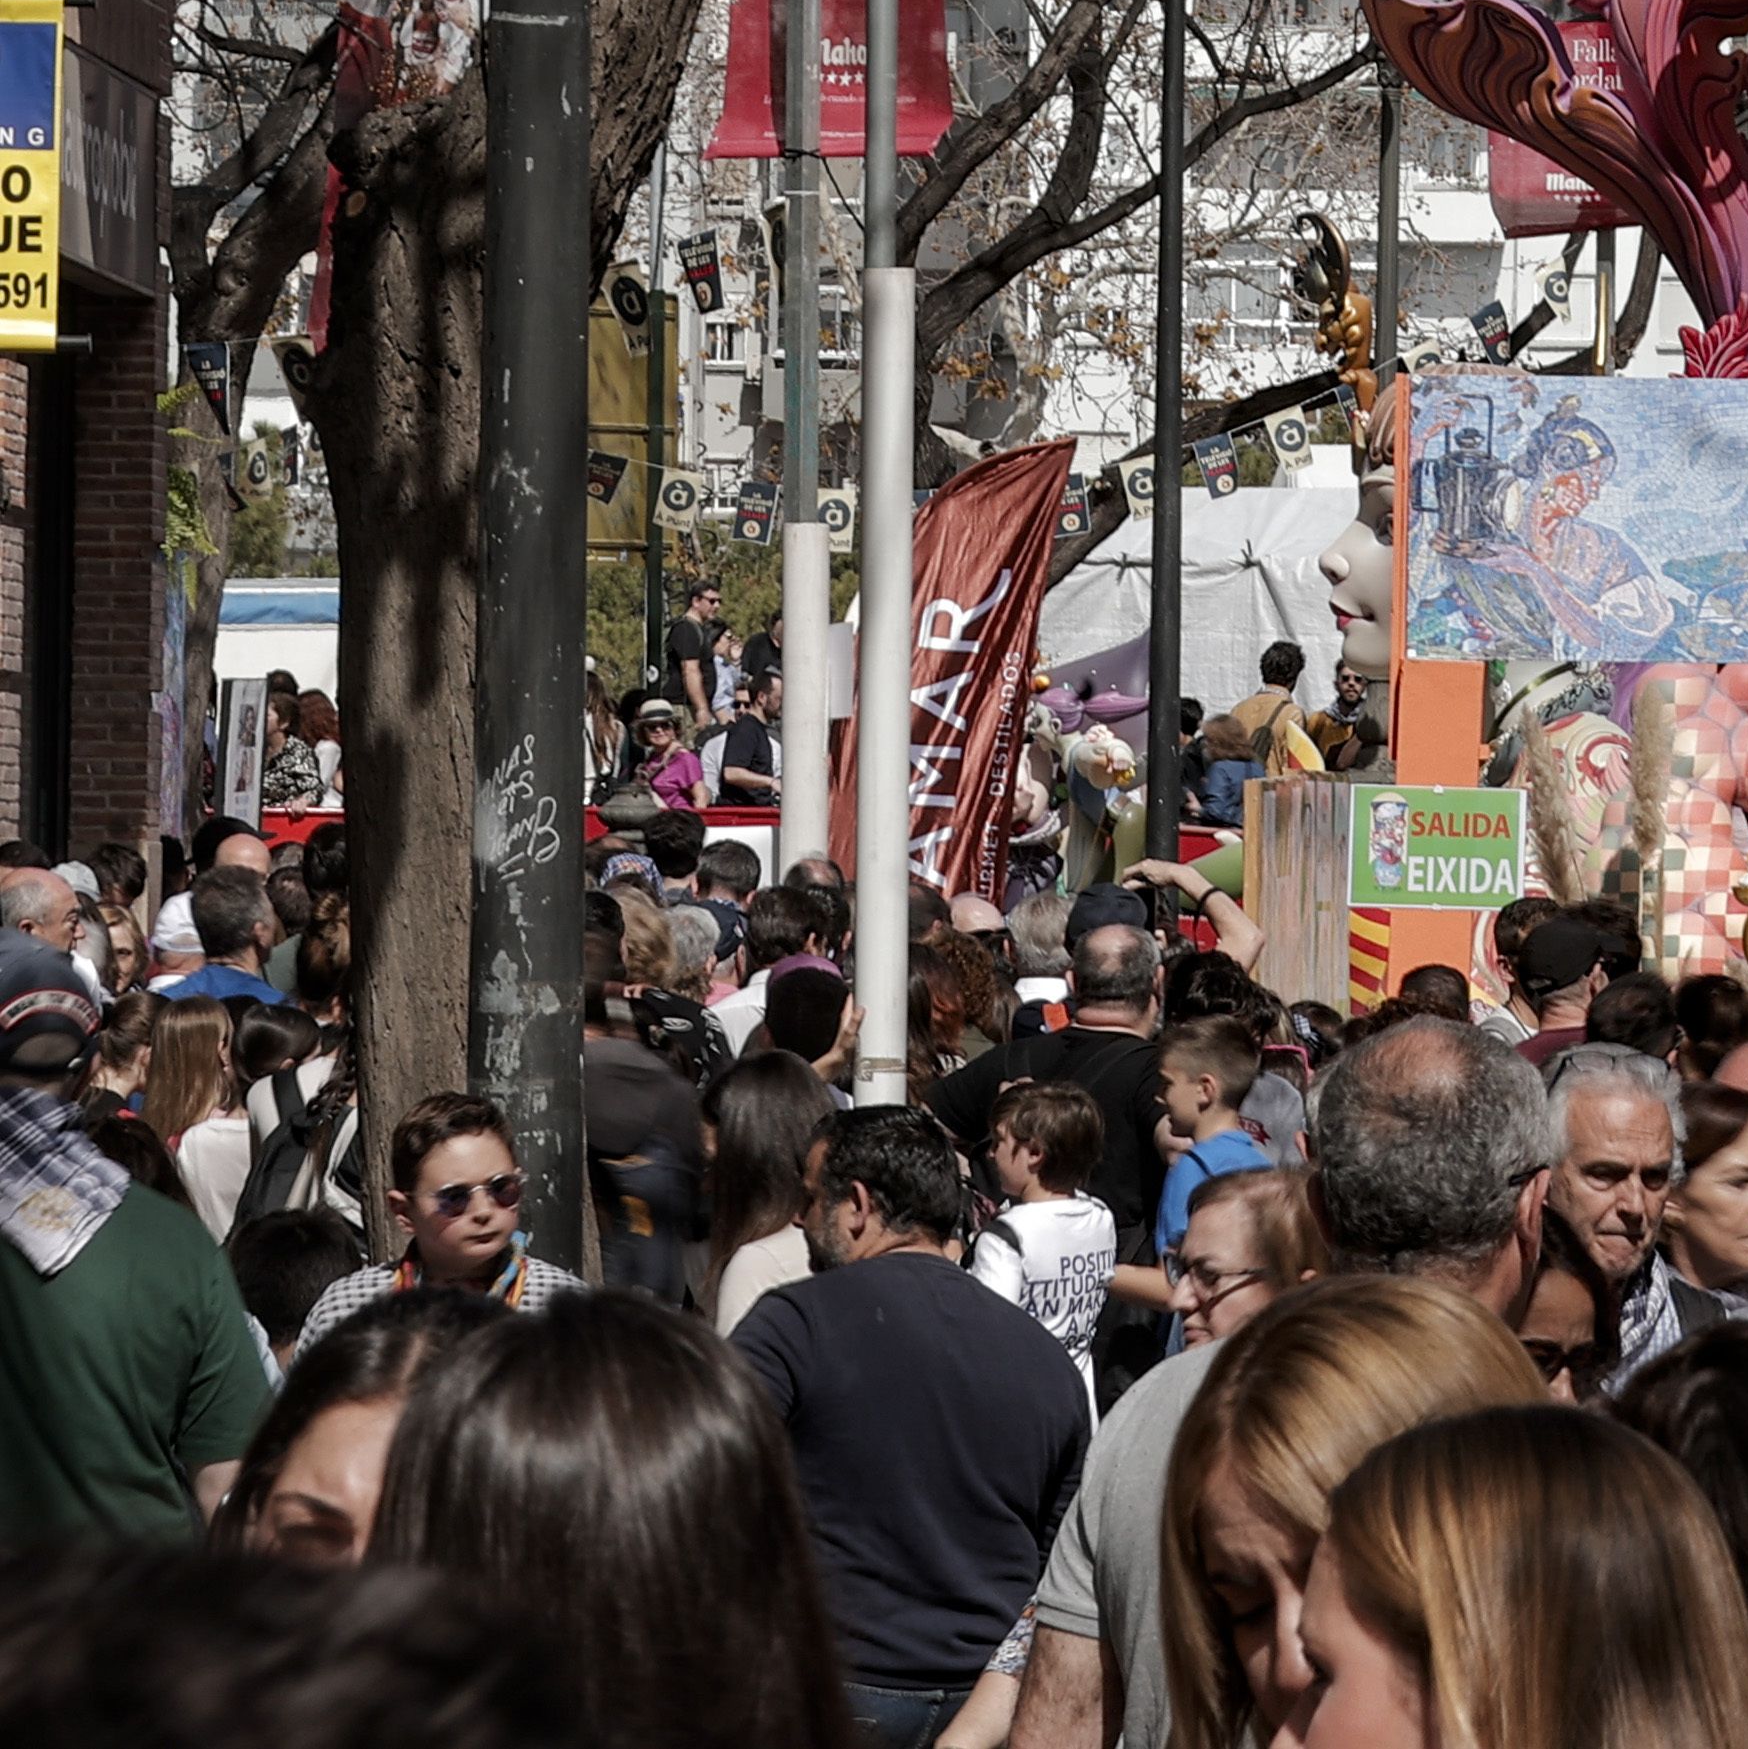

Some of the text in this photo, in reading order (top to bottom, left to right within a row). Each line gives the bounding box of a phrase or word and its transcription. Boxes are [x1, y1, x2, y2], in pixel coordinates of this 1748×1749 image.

[990, 650, 1022, 796] DESTILADOS
[1410, 811, 1512, 839] SALIDA
[1407, 855, 1516, 895] EIXIDA
